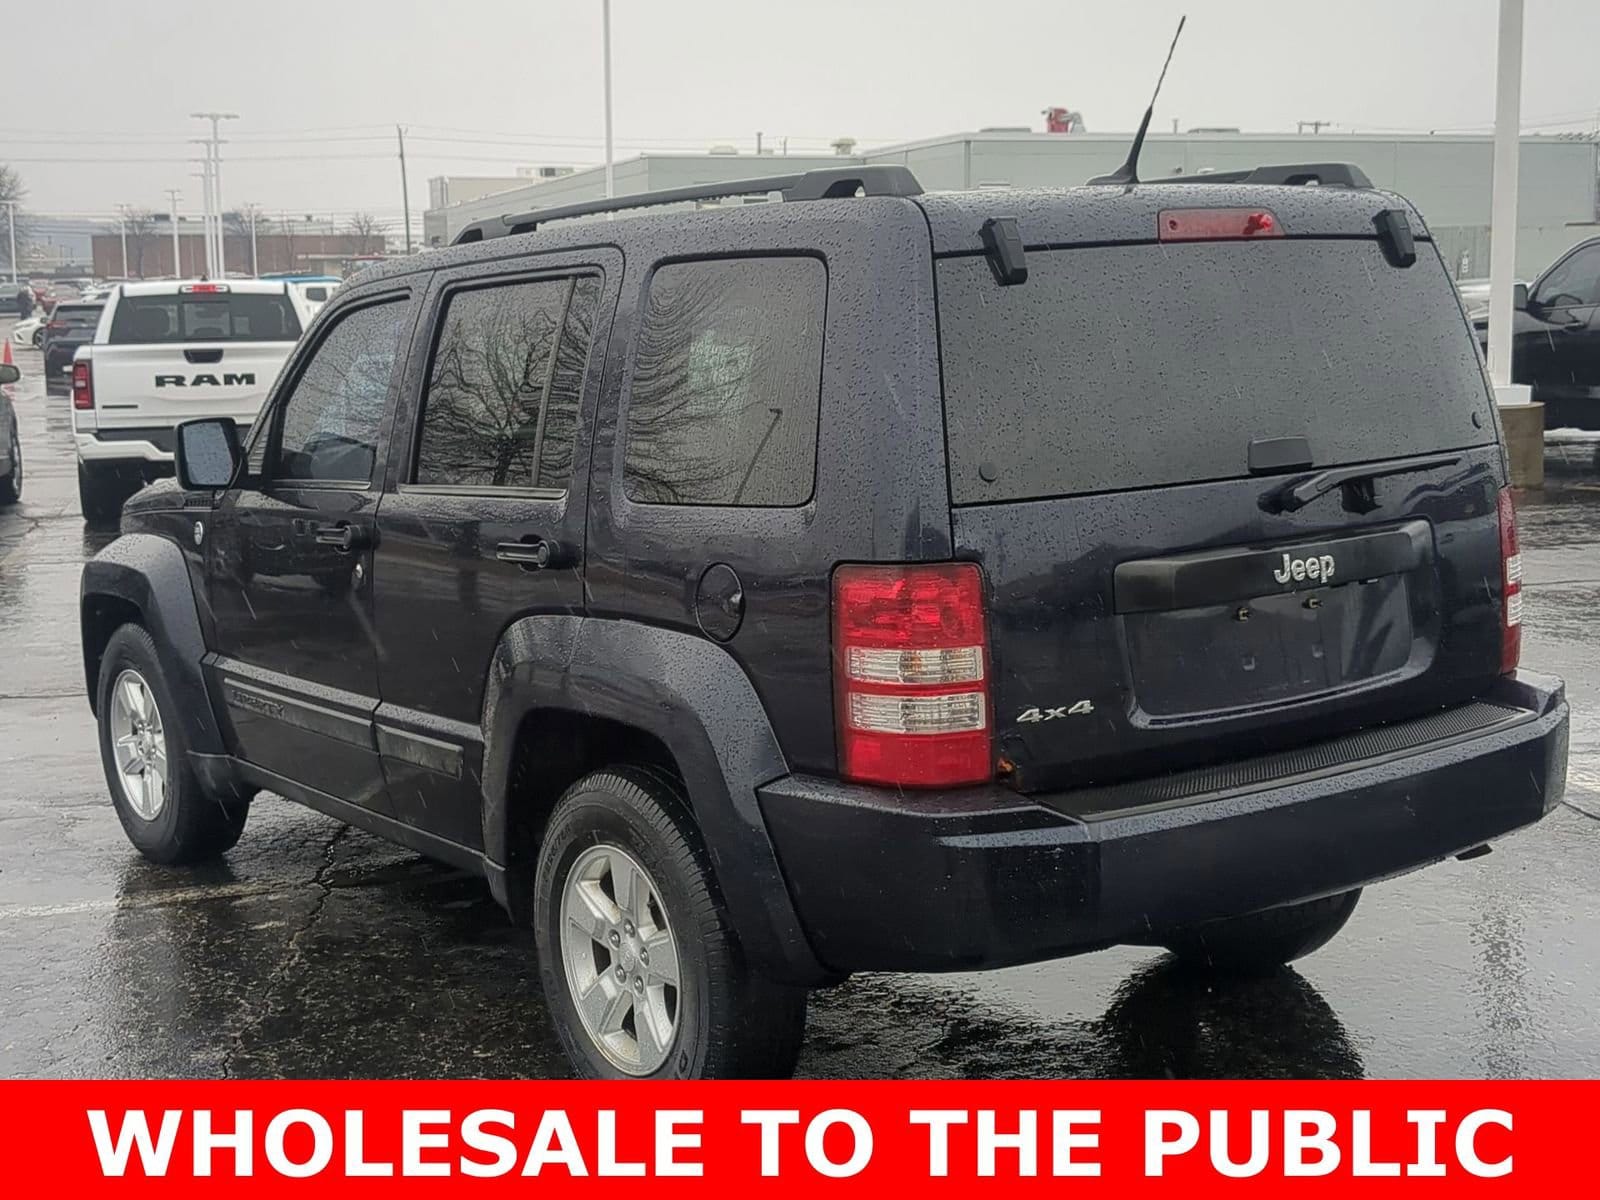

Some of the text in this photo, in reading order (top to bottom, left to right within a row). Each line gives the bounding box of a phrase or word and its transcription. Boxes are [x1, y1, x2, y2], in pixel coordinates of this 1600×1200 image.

[154, 373, 256, 388] RAM
[1273, 552, 1336, 586] Jeep
[1015, 699, 1095, 723] 4x4
